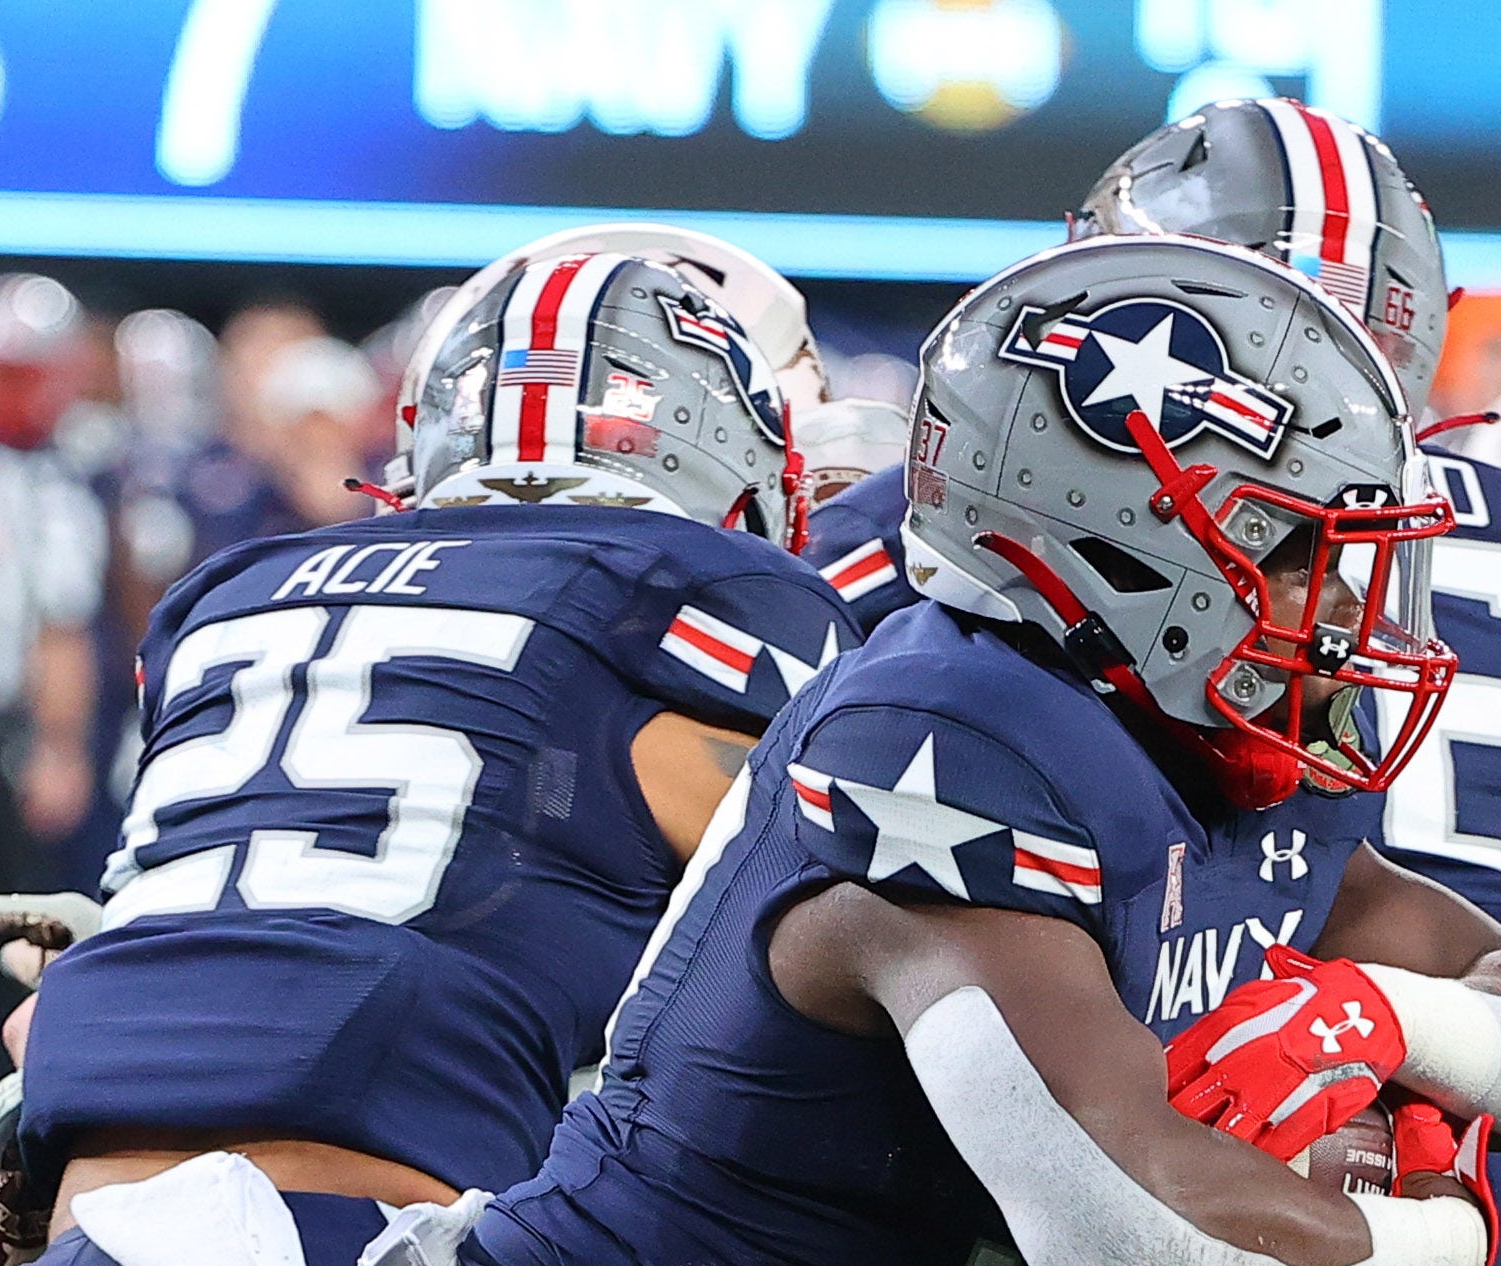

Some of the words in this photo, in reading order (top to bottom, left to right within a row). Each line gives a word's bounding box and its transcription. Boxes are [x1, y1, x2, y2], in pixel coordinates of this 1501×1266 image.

[1385, 286, 1415, 331] 66
[917, 419, 947, 467] 37
[270, 540, 473, 601] ACIE
[100, 604, 536, 936] 25
[1145, 909, 1304, 1025] NAVY
[1345, 1149, 1387, 1169] ISSUE
